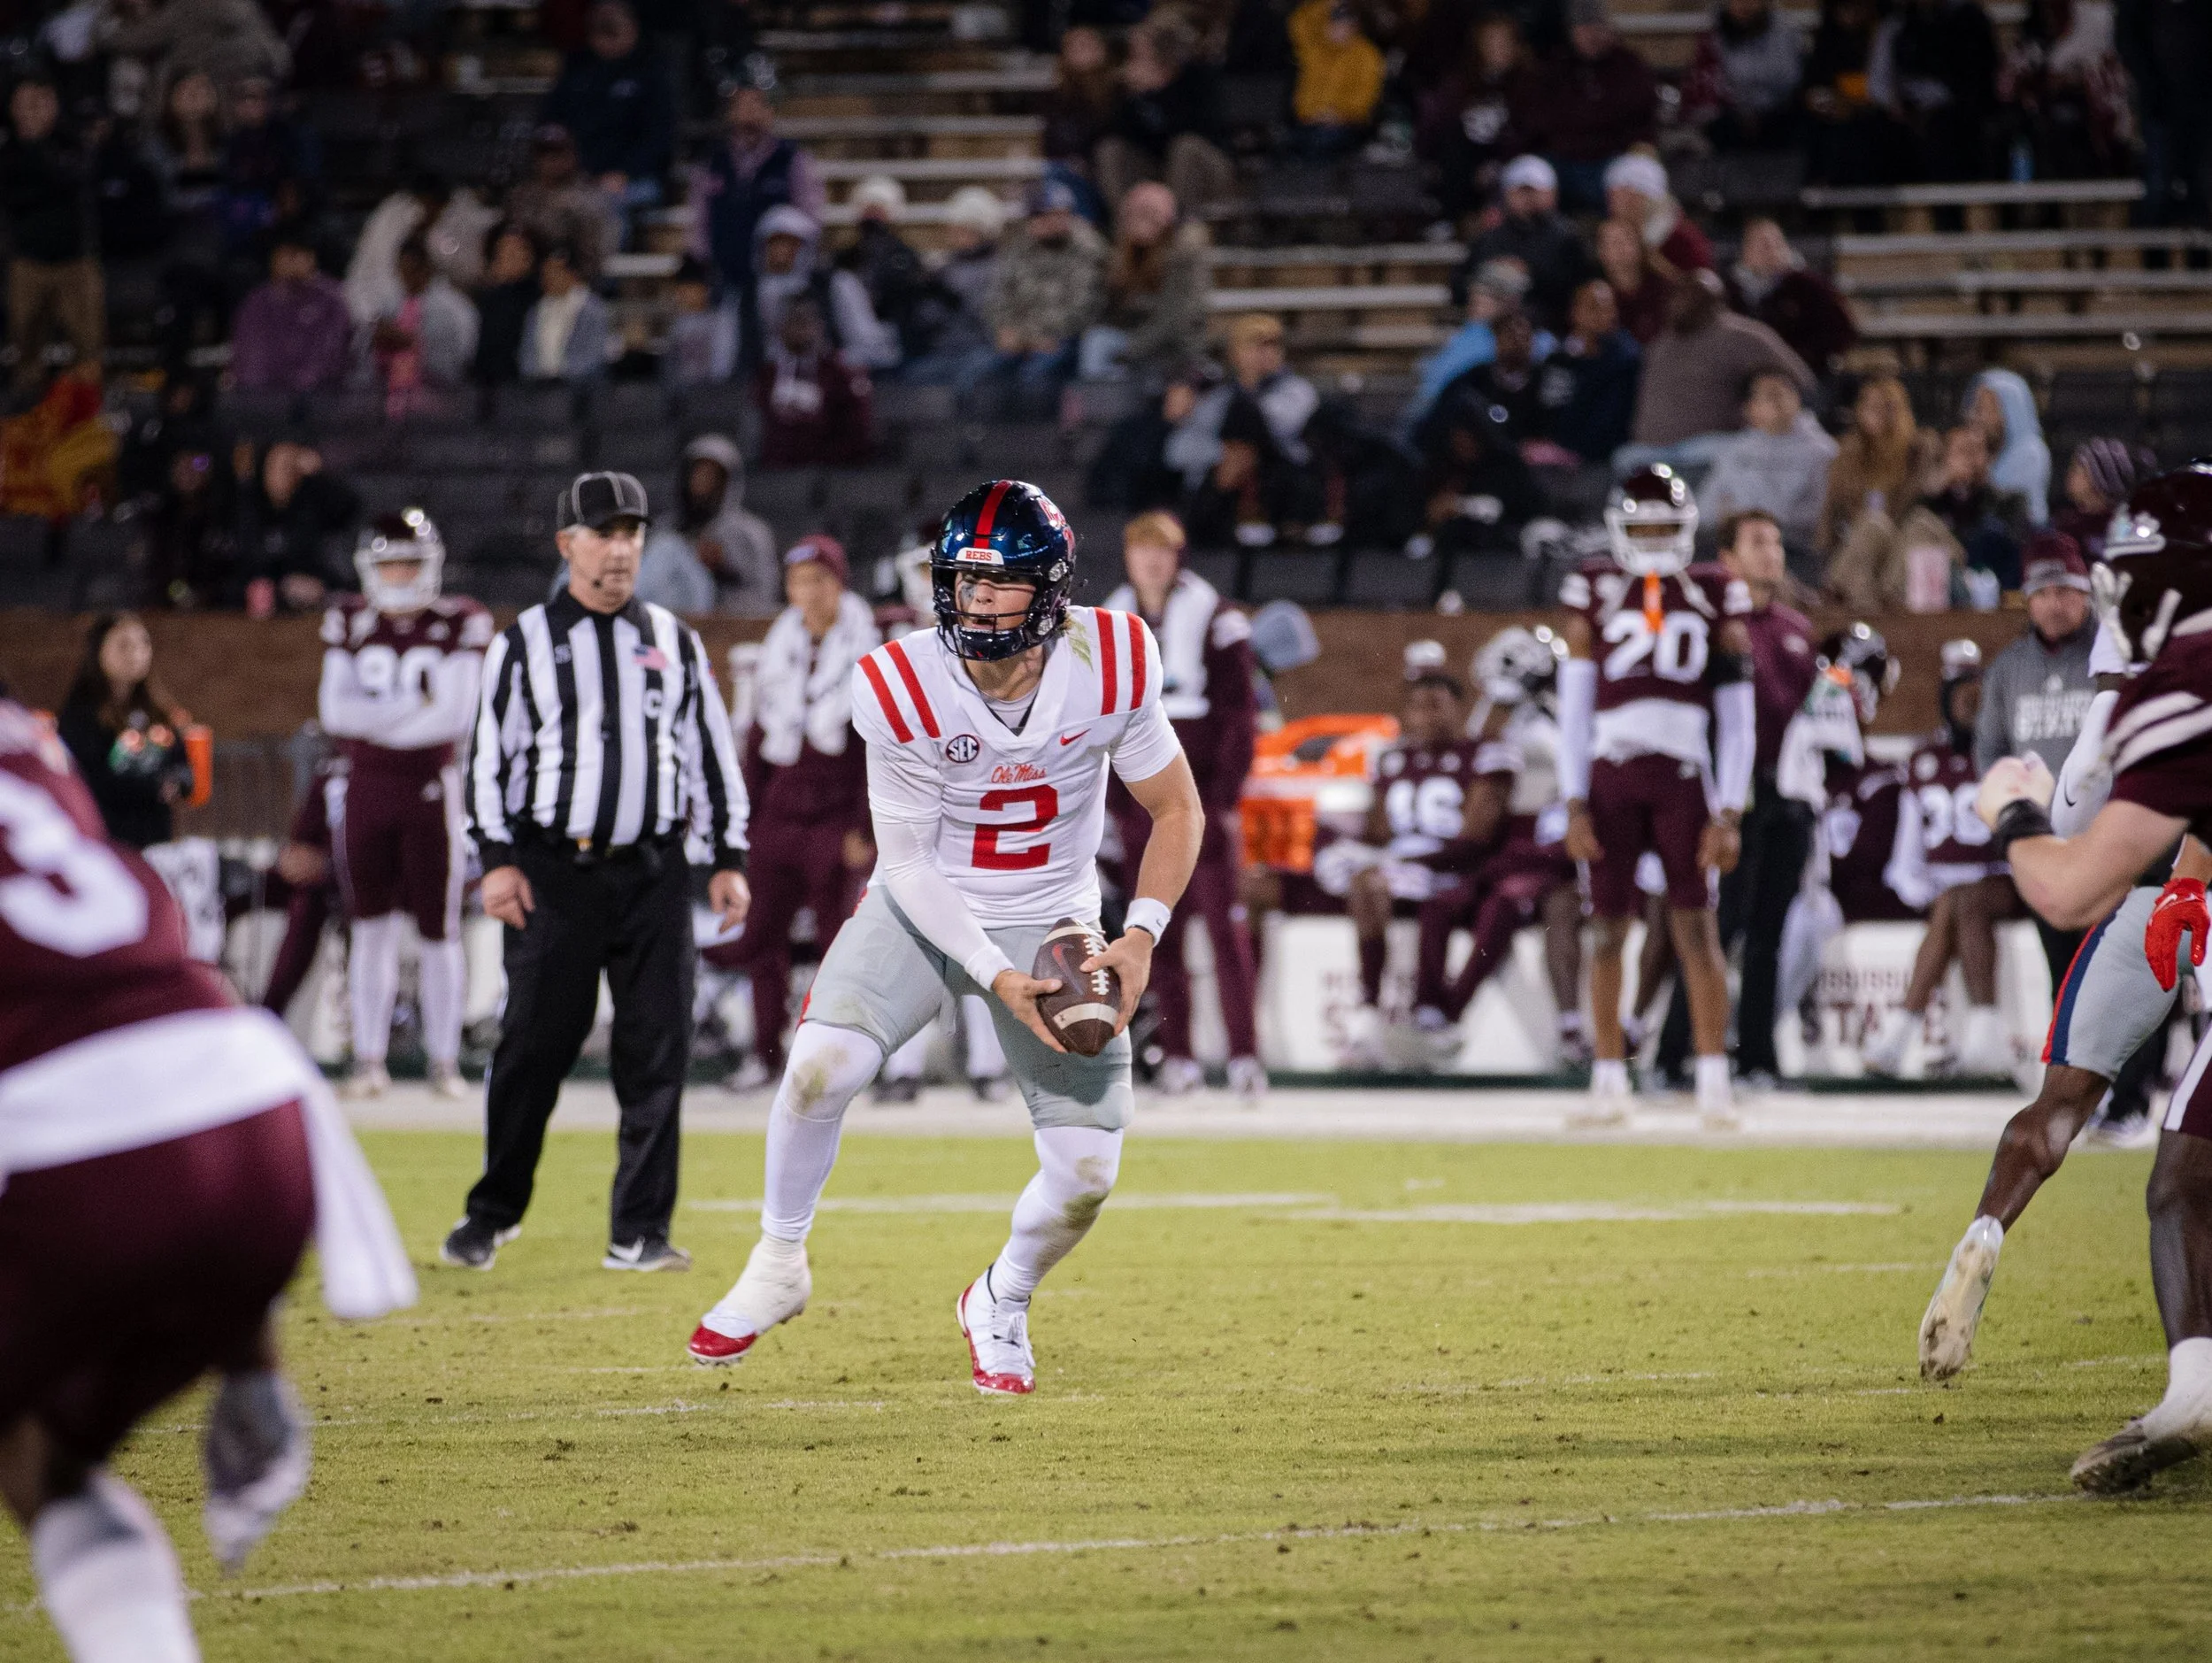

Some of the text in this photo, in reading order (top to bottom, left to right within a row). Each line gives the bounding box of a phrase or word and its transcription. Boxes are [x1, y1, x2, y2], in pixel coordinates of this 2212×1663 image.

[965, 550, 992, 562] REBS
[1602, 609, 1709, 683] 20
[643, 689, 664, 720] C
[947, 735, 979, 762] SEC
[991, 763, 1048, 784] Ole Miss
[1386, 775, 1465, 838] 16
[972, 784, 1059, 870] 2
